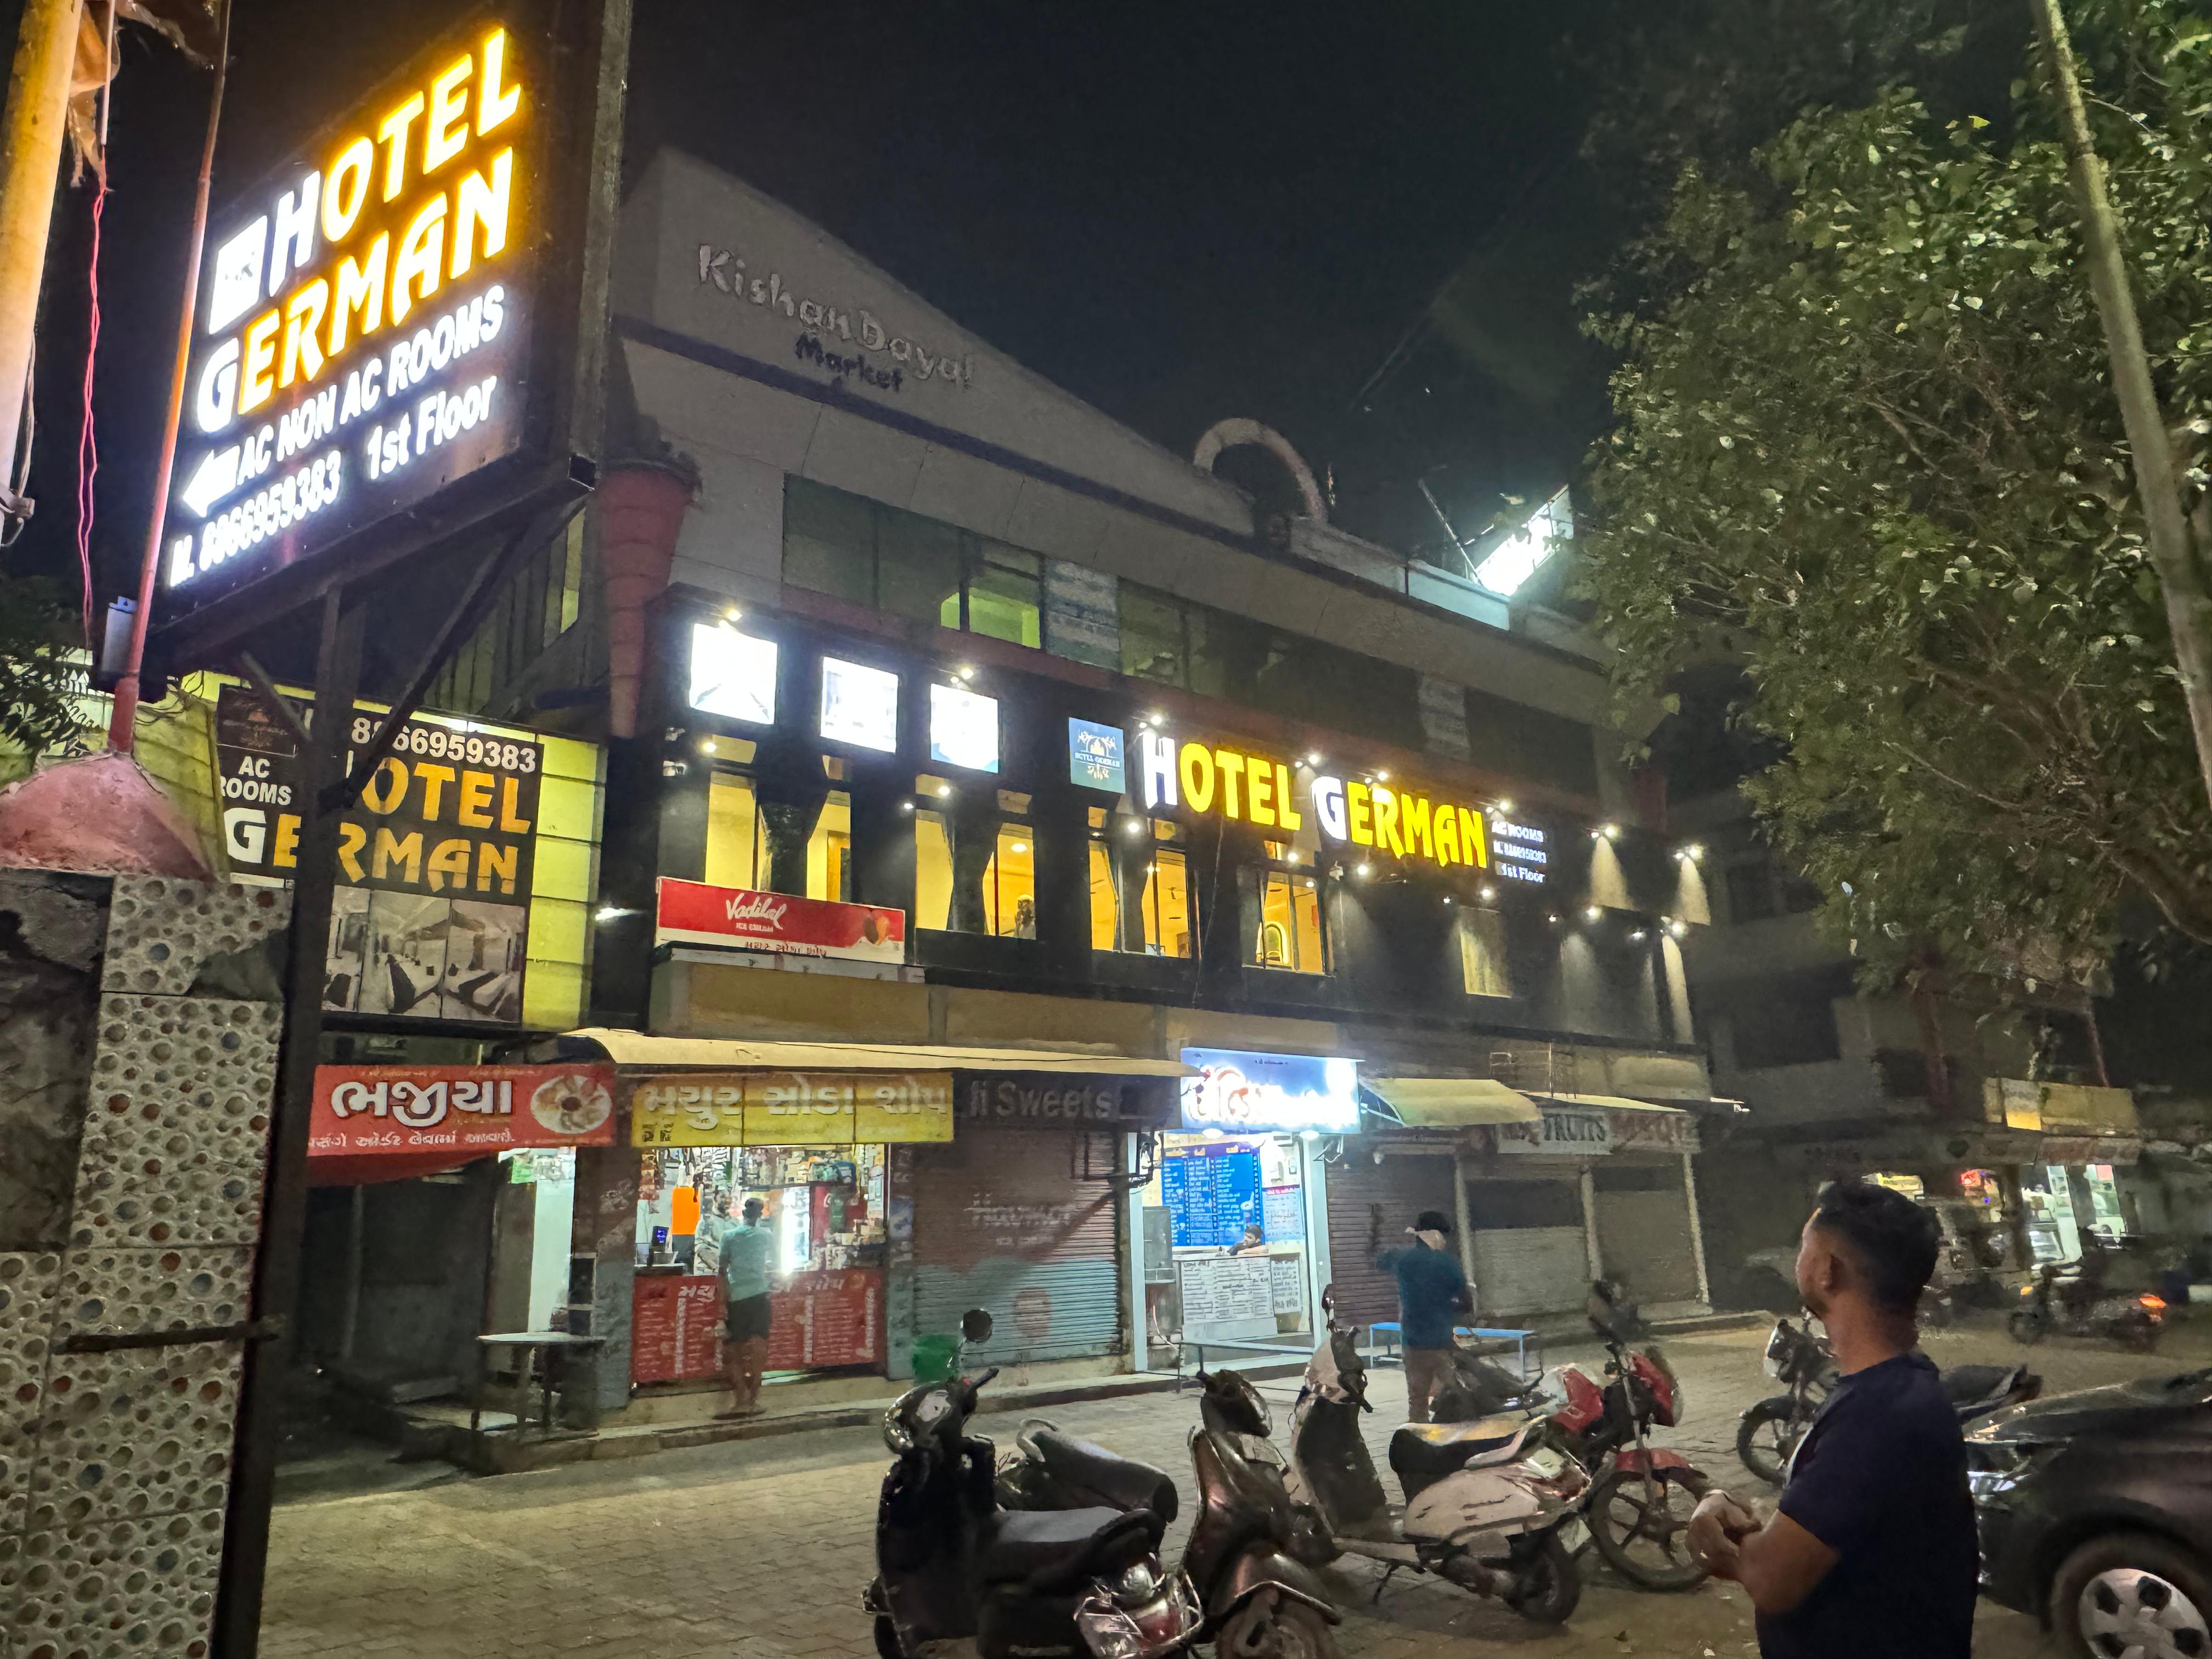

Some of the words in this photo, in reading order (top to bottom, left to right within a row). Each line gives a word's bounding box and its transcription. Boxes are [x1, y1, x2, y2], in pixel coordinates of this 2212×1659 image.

[268, 27, 521, 297] HOTEL
[196, 146, 512, 432] GERMAN
[236, 425, 274, 485] AC
[276, 385, 337, 461] NON
[340, 358, 382, 424] AC
[387, 285, 504, 397] ROOMS
[367, 411, 411, 480] 1st
[416, 376, 497, 455] Floor
[238, 756, 270, 778] AC
[346, 750, 531, 834] OTEL
[1141, 730, 1301, 831] HOTEL
[1311, 776, 1487, 868] GERMAN
[726, 892, 787, 930] Vadilal
[331, 1081, 512, 1127] ભજીયા
[644, 1085, 742, 1130] મયુર
[996, 1080, 1113, 1118] Sweets
